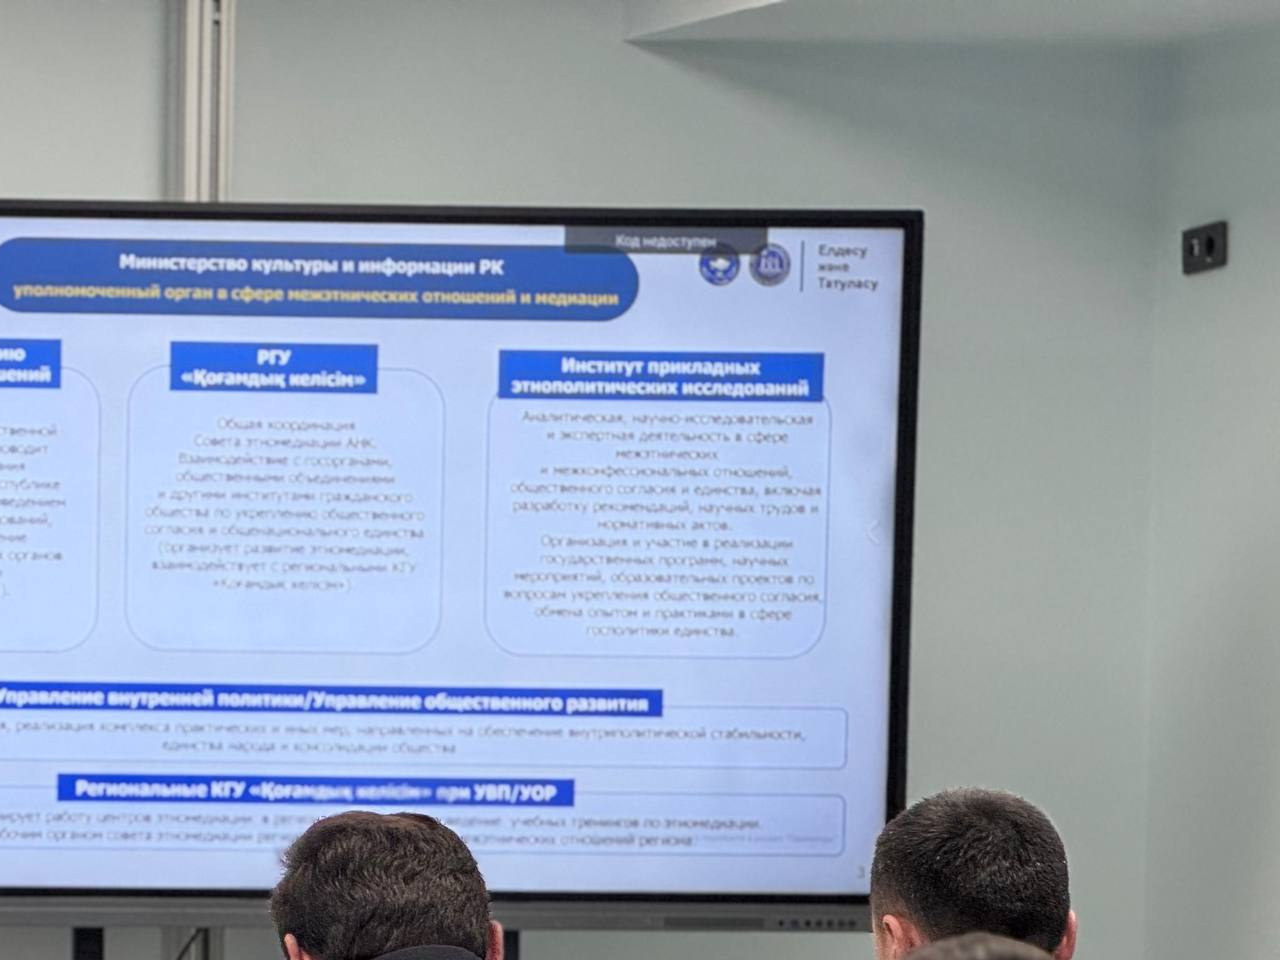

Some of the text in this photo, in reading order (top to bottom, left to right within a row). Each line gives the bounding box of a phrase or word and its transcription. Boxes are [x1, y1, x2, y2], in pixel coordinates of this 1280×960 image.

[119, 254, 504, 276] Министерство культуры и информации РК
[13, 284, 619, 307] уполномоченный орган в сфере межэтнических отношений и медиации
[257, 349, 292, 365] РГУ
[561, 358, 760, 377] Институт прикладных
[511, 379, 809, 397] этнополитических исследований
[108, 689, 214, 708] внутренней
[217, 691, 422, 711] политики/Управление
[425, 694, 563, 713] общественного
[567, 698, 649, 714] развития
[75, 780, 206, 799] Региональные
[212, 782, 246, 797] КГУ
[436, 787, 471, 802] при
[474, 784, 558, 802] УВП/УОР
